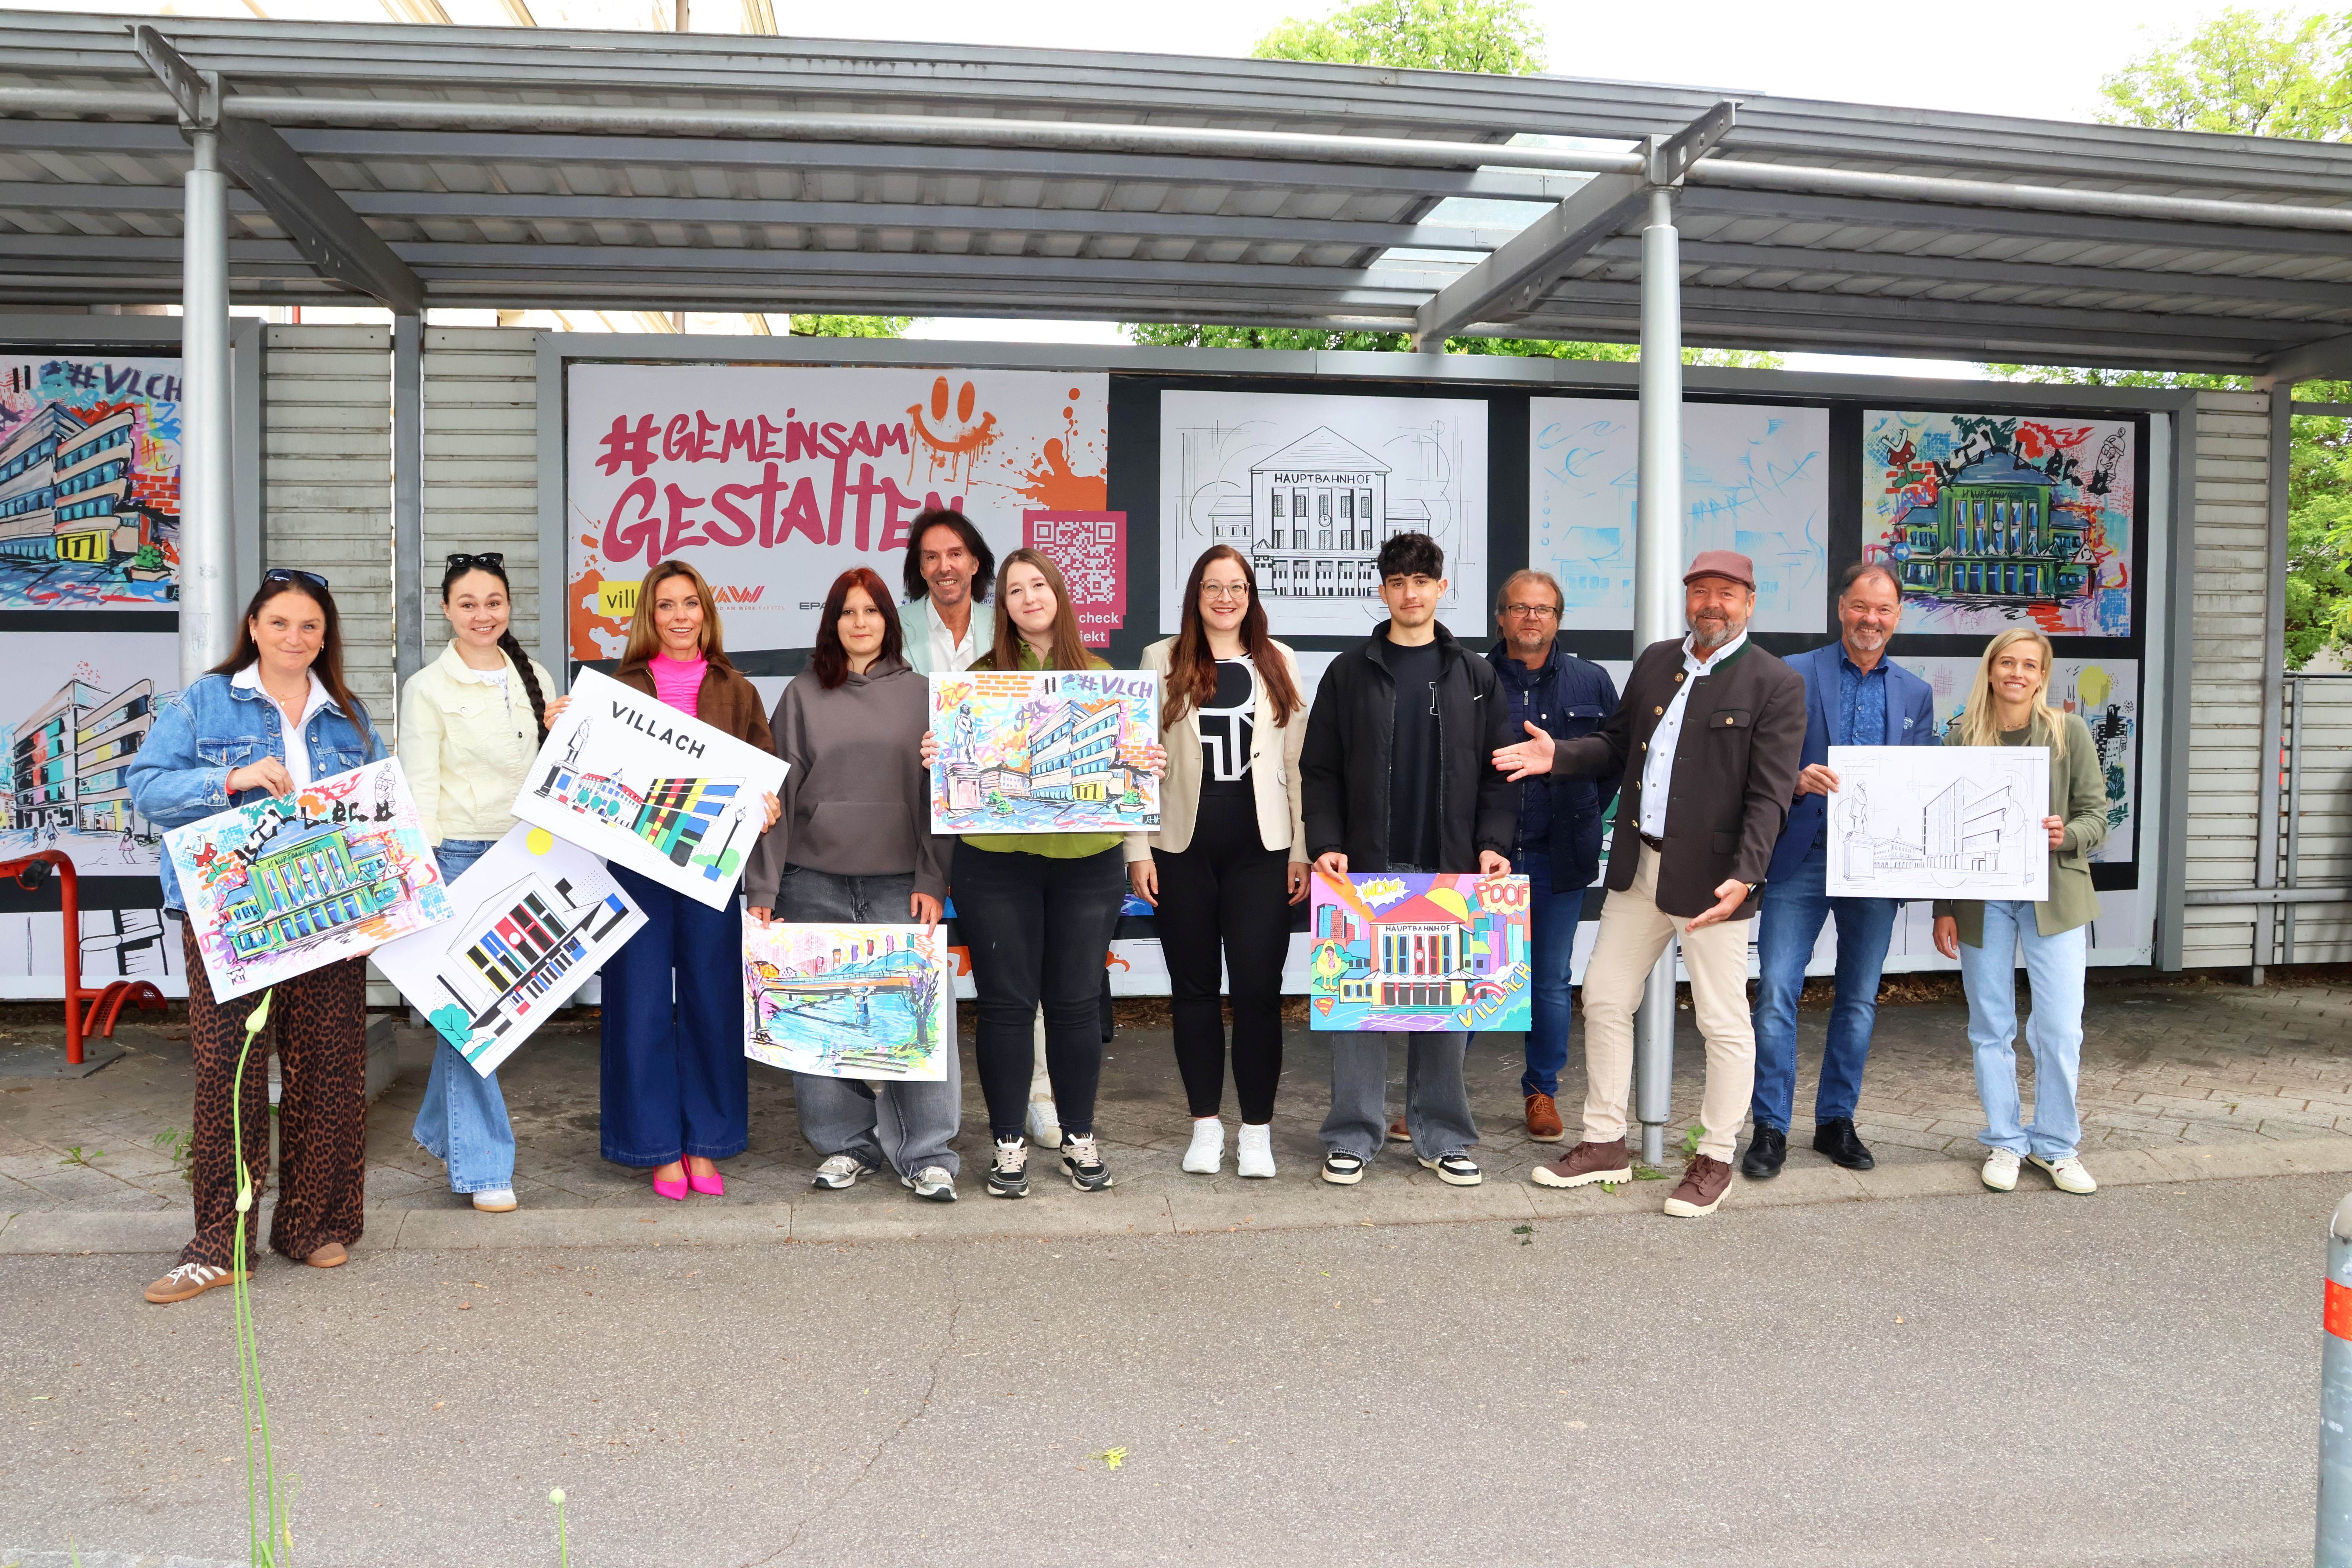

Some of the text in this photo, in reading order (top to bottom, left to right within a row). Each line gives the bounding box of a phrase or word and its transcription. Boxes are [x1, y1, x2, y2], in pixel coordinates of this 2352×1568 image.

[1274, 473, 1371, 484] HAUPTBAHNHOF
[606, 589, 634, 608] vill
[1078, 612, 1119, 623] check
[1080, 630, 1106, 644] jekt
[1078, 673, 1154, 699] #VLCH
[612, 701, 706, 759] VILLACH
[1361, 880, 1403, 900] WOW!
[1473, 882, 1530, 907] POOF
[1457, 960, 1532, 1028] VILLACH
